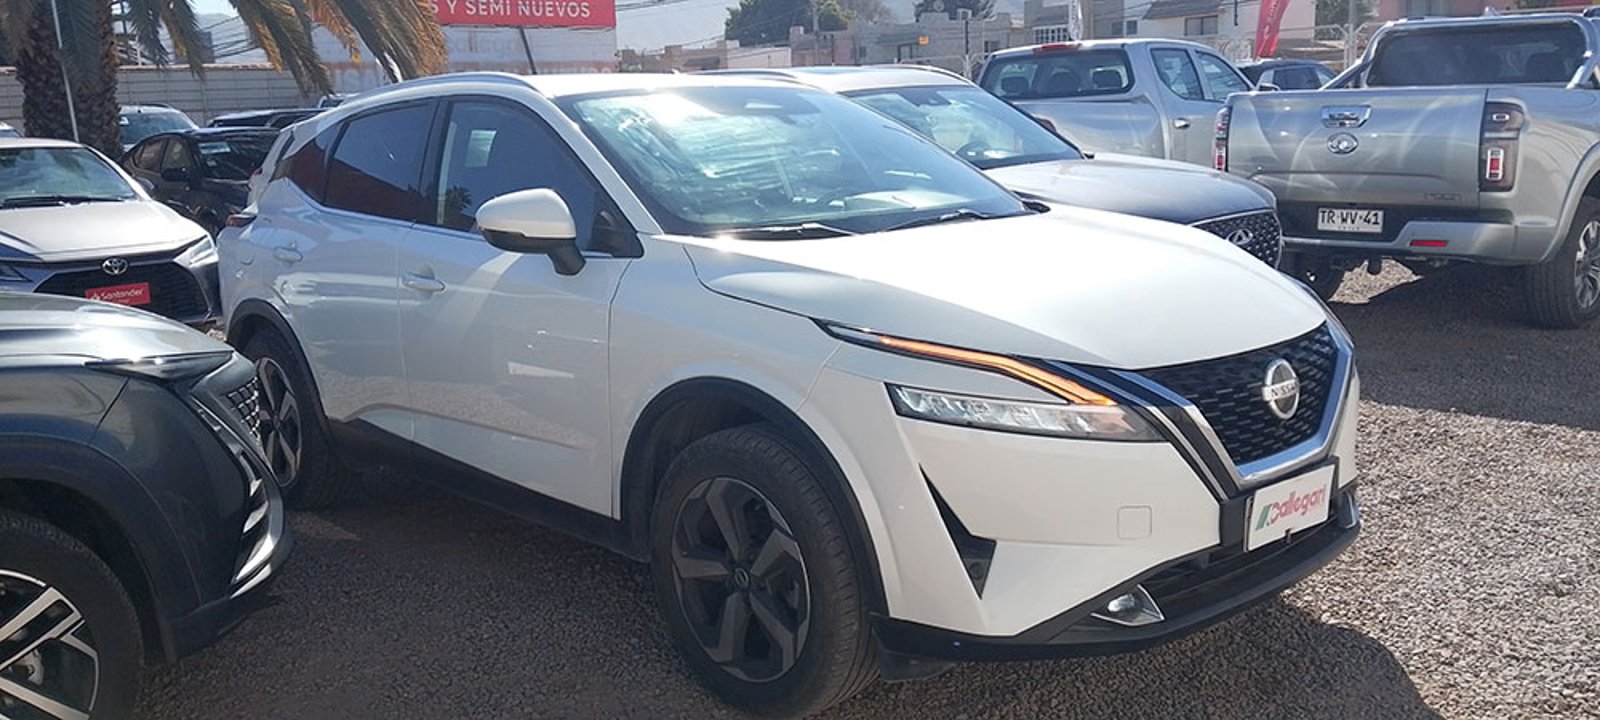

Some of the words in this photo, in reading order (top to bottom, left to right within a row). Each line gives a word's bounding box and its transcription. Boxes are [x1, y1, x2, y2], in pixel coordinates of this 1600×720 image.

[447, 0, 459, 14] Y
[466, 0, 511, 16] SEMI
[518, 1, 590, 18] NUEVOS
